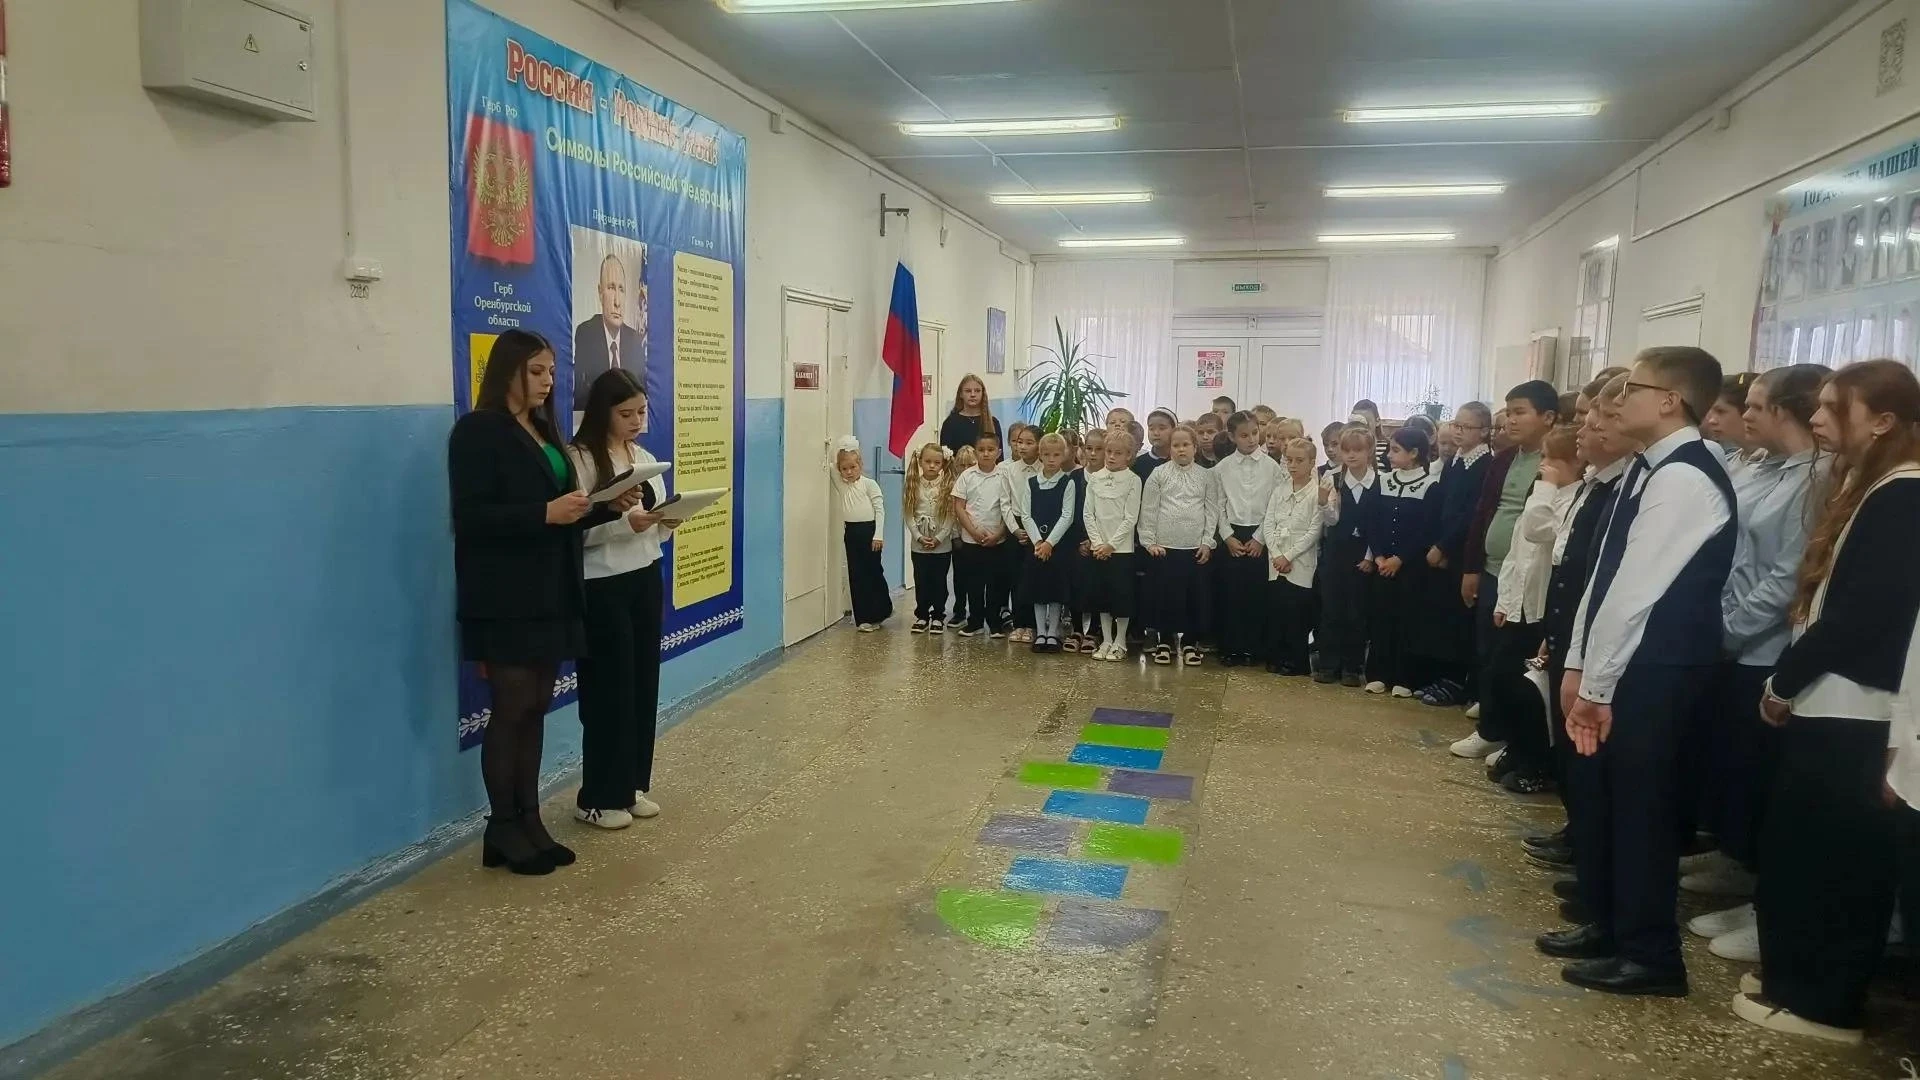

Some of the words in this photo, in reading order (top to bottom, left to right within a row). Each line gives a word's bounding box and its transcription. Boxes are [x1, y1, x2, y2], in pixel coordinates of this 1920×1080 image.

[481, 95, 502, 114] Герб
[505, 104, 518, 119] РФ
[1868, 142, 1919, 181] НАШЕЙ
[613, 152, 678, 194] Российской
[493, 281, 513, 297] Герб
[474, 295, 531, 313] Оренбургской
[488, 314, 520, 328] области
